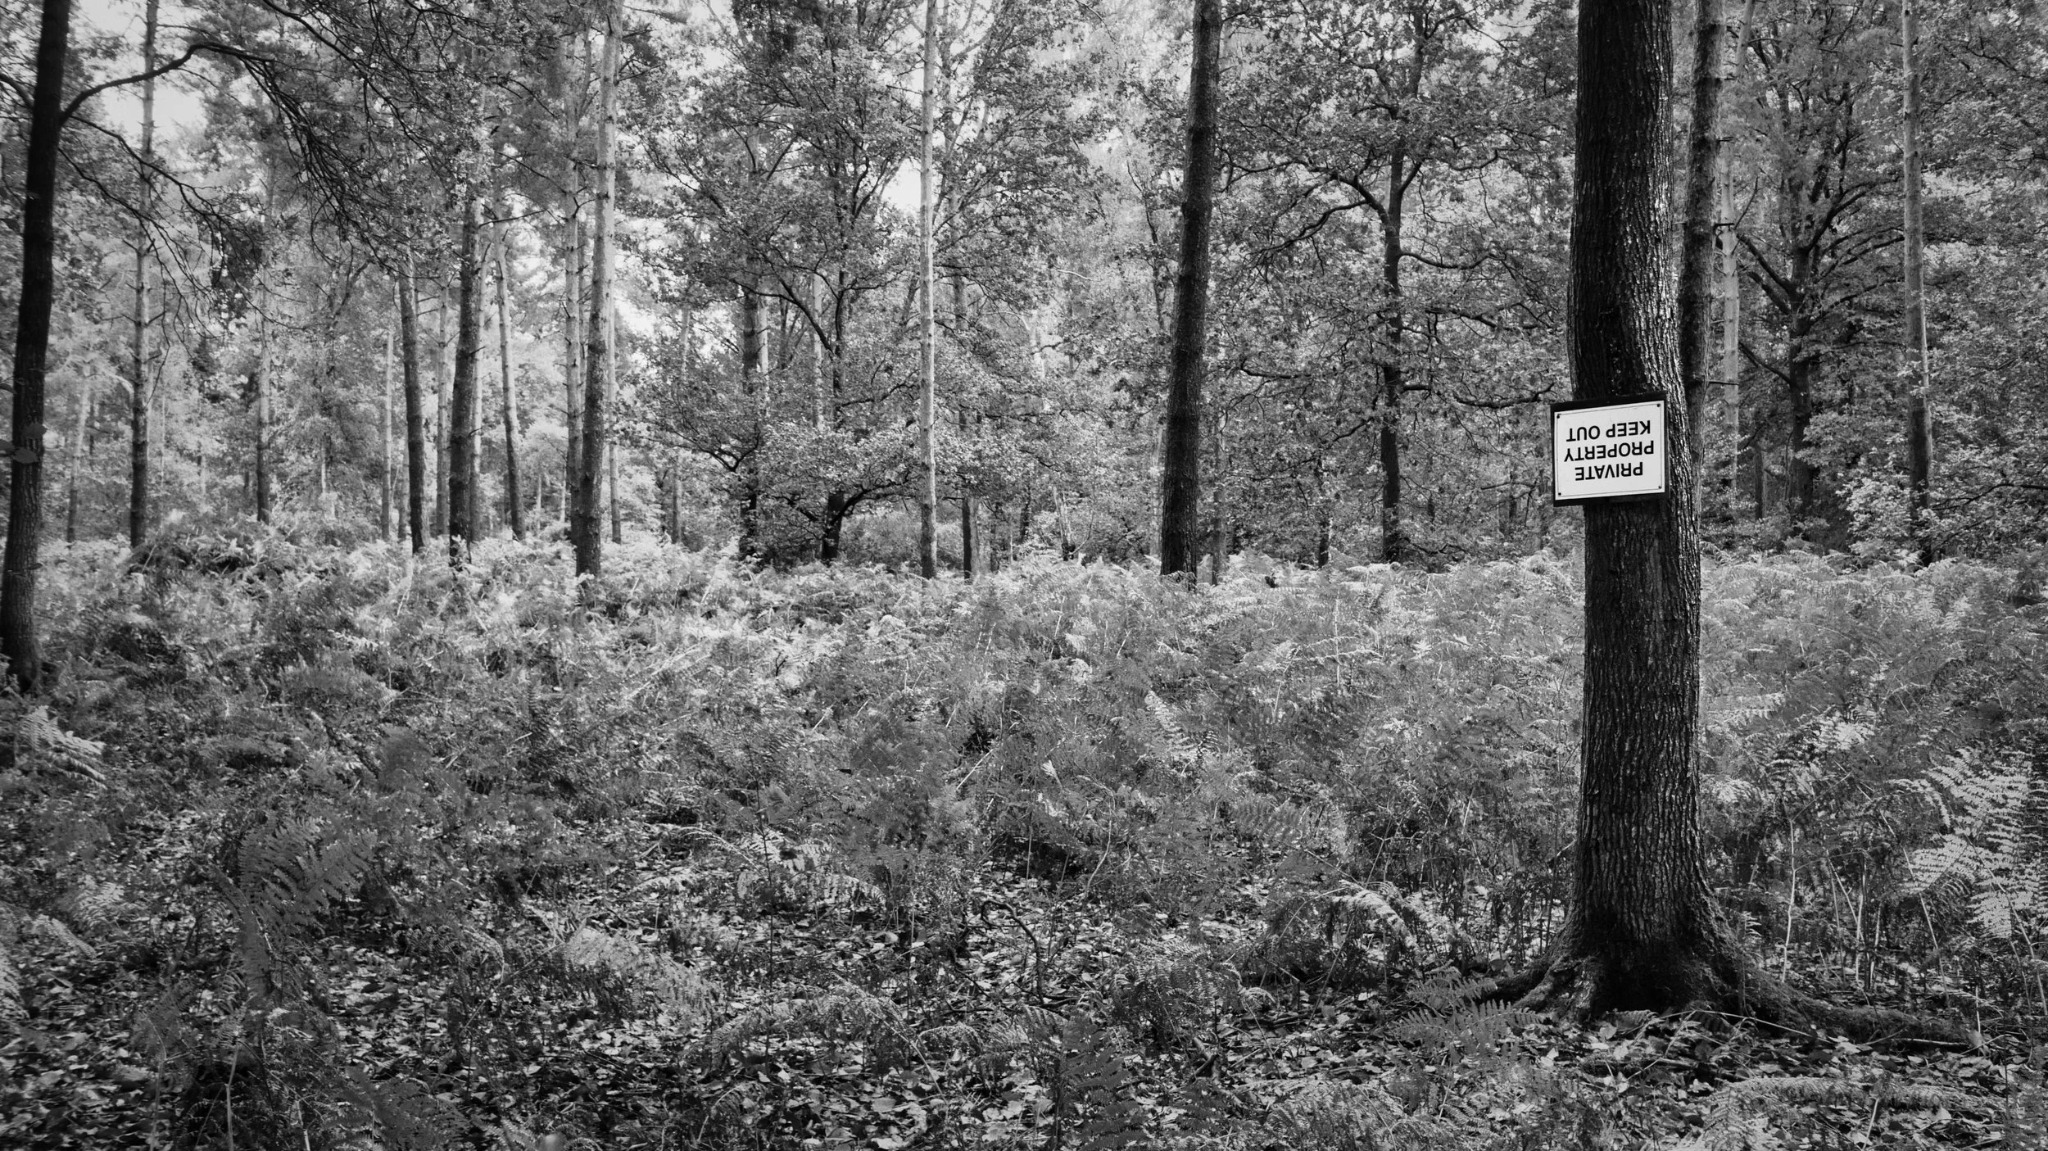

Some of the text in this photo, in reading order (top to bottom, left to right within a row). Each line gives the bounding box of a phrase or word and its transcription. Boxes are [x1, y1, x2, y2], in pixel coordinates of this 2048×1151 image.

[1566, 420, 1651, 442] KEEP OUT
[1564, 440, 1654, 462] PROPERTY
[1575, 462, 1643, 481] PRIVATE
